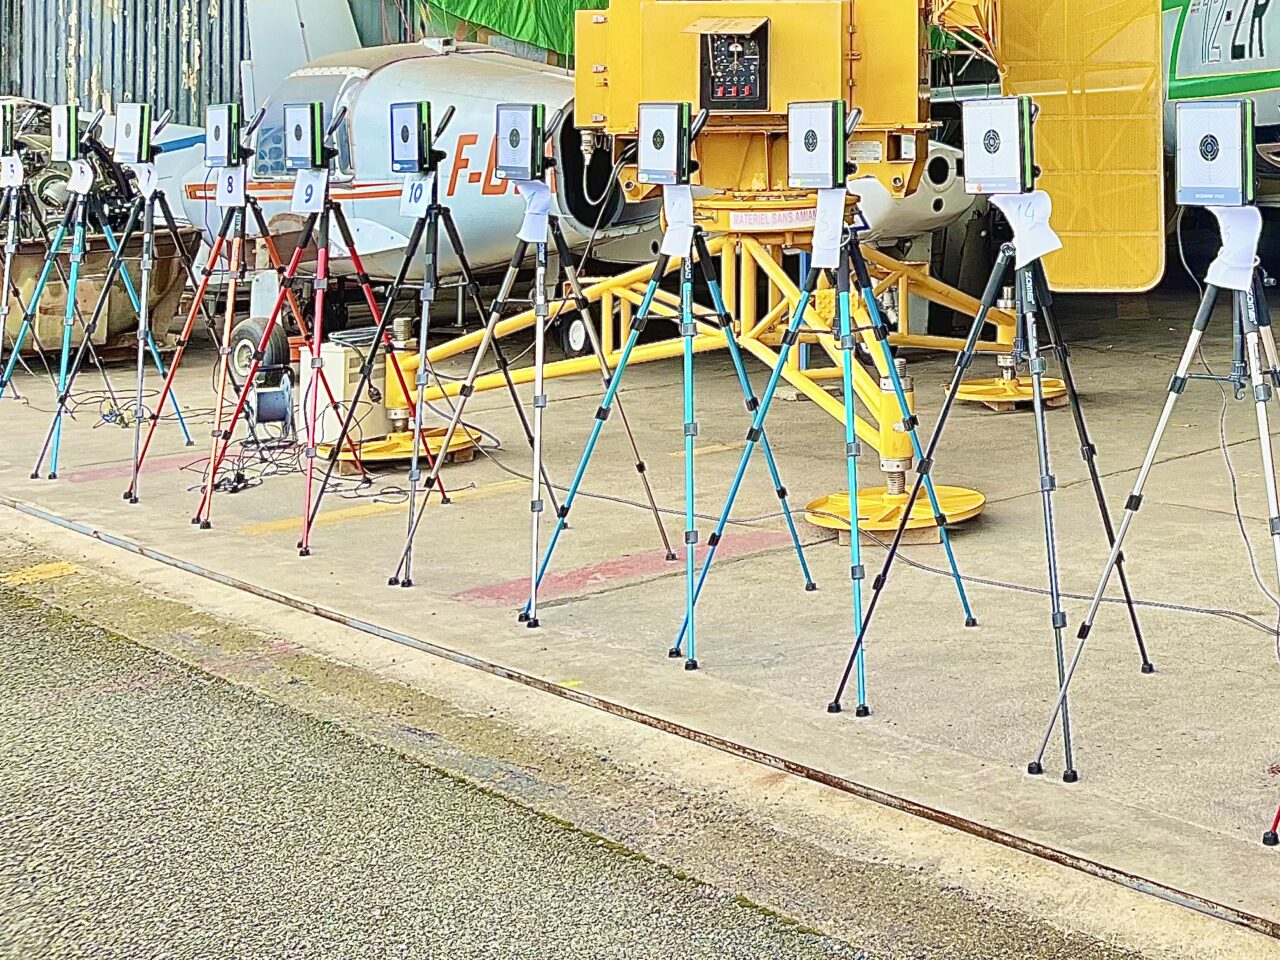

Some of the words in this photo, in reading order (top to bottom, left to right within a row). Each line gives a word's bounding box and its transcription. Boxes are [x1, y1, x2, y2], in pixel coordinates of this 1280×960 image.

[227, 175, 234, 194] 8
[304, 184, 314, 204] 9
[408, 182, 423, 204] 10
[772, 212, 793, 224] SANS
